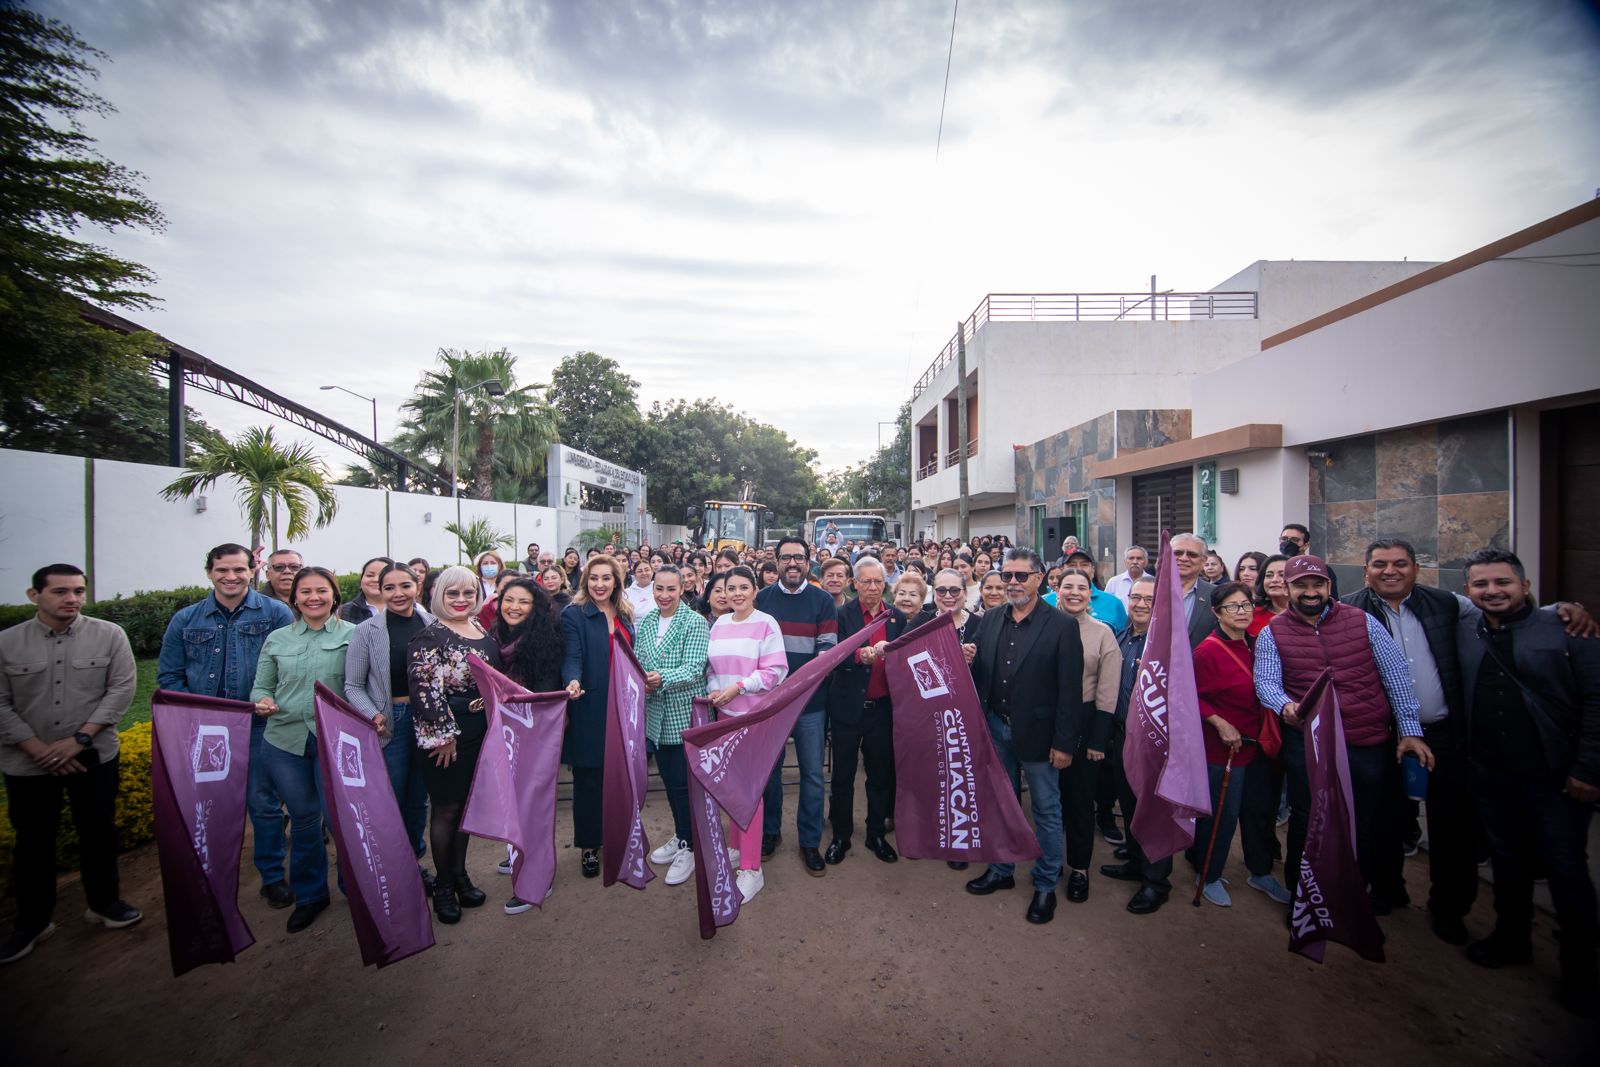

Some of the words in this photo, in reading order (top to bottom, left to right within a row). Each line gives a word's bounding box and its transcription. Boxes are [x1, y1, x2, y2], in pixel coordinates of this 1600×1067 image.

[933, 710, 944, 756] CAPITAL
[938, 761, 946, 777] DE
[943, 709, 970, 850] CULIACÁN
[953, 707, 979, 823] AYUNTAMIENTO
[970, 826, 981, 849] DE
[1314, 907, 1334, 929] DE
